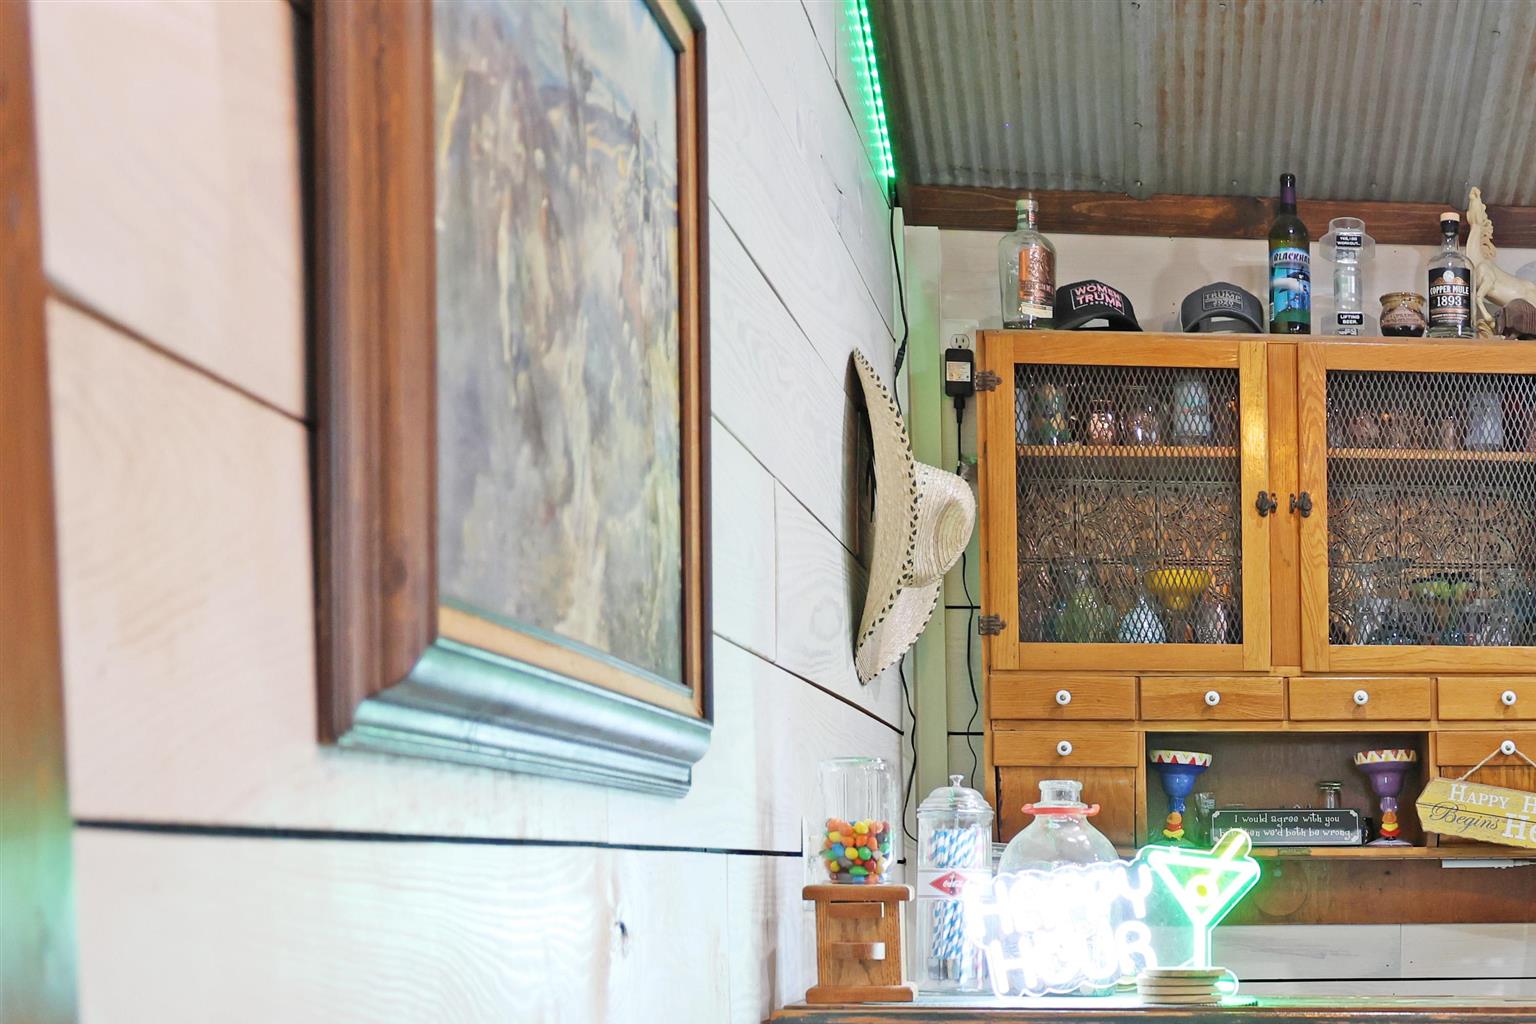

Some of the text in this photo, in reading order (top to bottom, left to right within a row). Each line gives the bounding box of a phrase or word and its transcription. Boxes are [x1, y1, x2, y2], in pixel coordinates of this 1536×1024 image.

[1074, 283, 1120, 301] WOMEN
[1205, 289, 1241, 300] TRUMP
[1430, 285, 1469, 295] COPPER MULE
[1076, 292, 1122, 308] TRUMP
[1436, 295, 1462, 307] 1893
[1447, 783, 1510, 810] HAPPY
[1233, 812, 1340, 828] I would agree with you
[1429, 801, 1500, 833] Begins
[1263, 827, 1283, 837] we'd
[1285, 826, 1307, 837] both
[1308, 827, 1320, 837] be
[1322, 829, 1354, 841] wrong.
